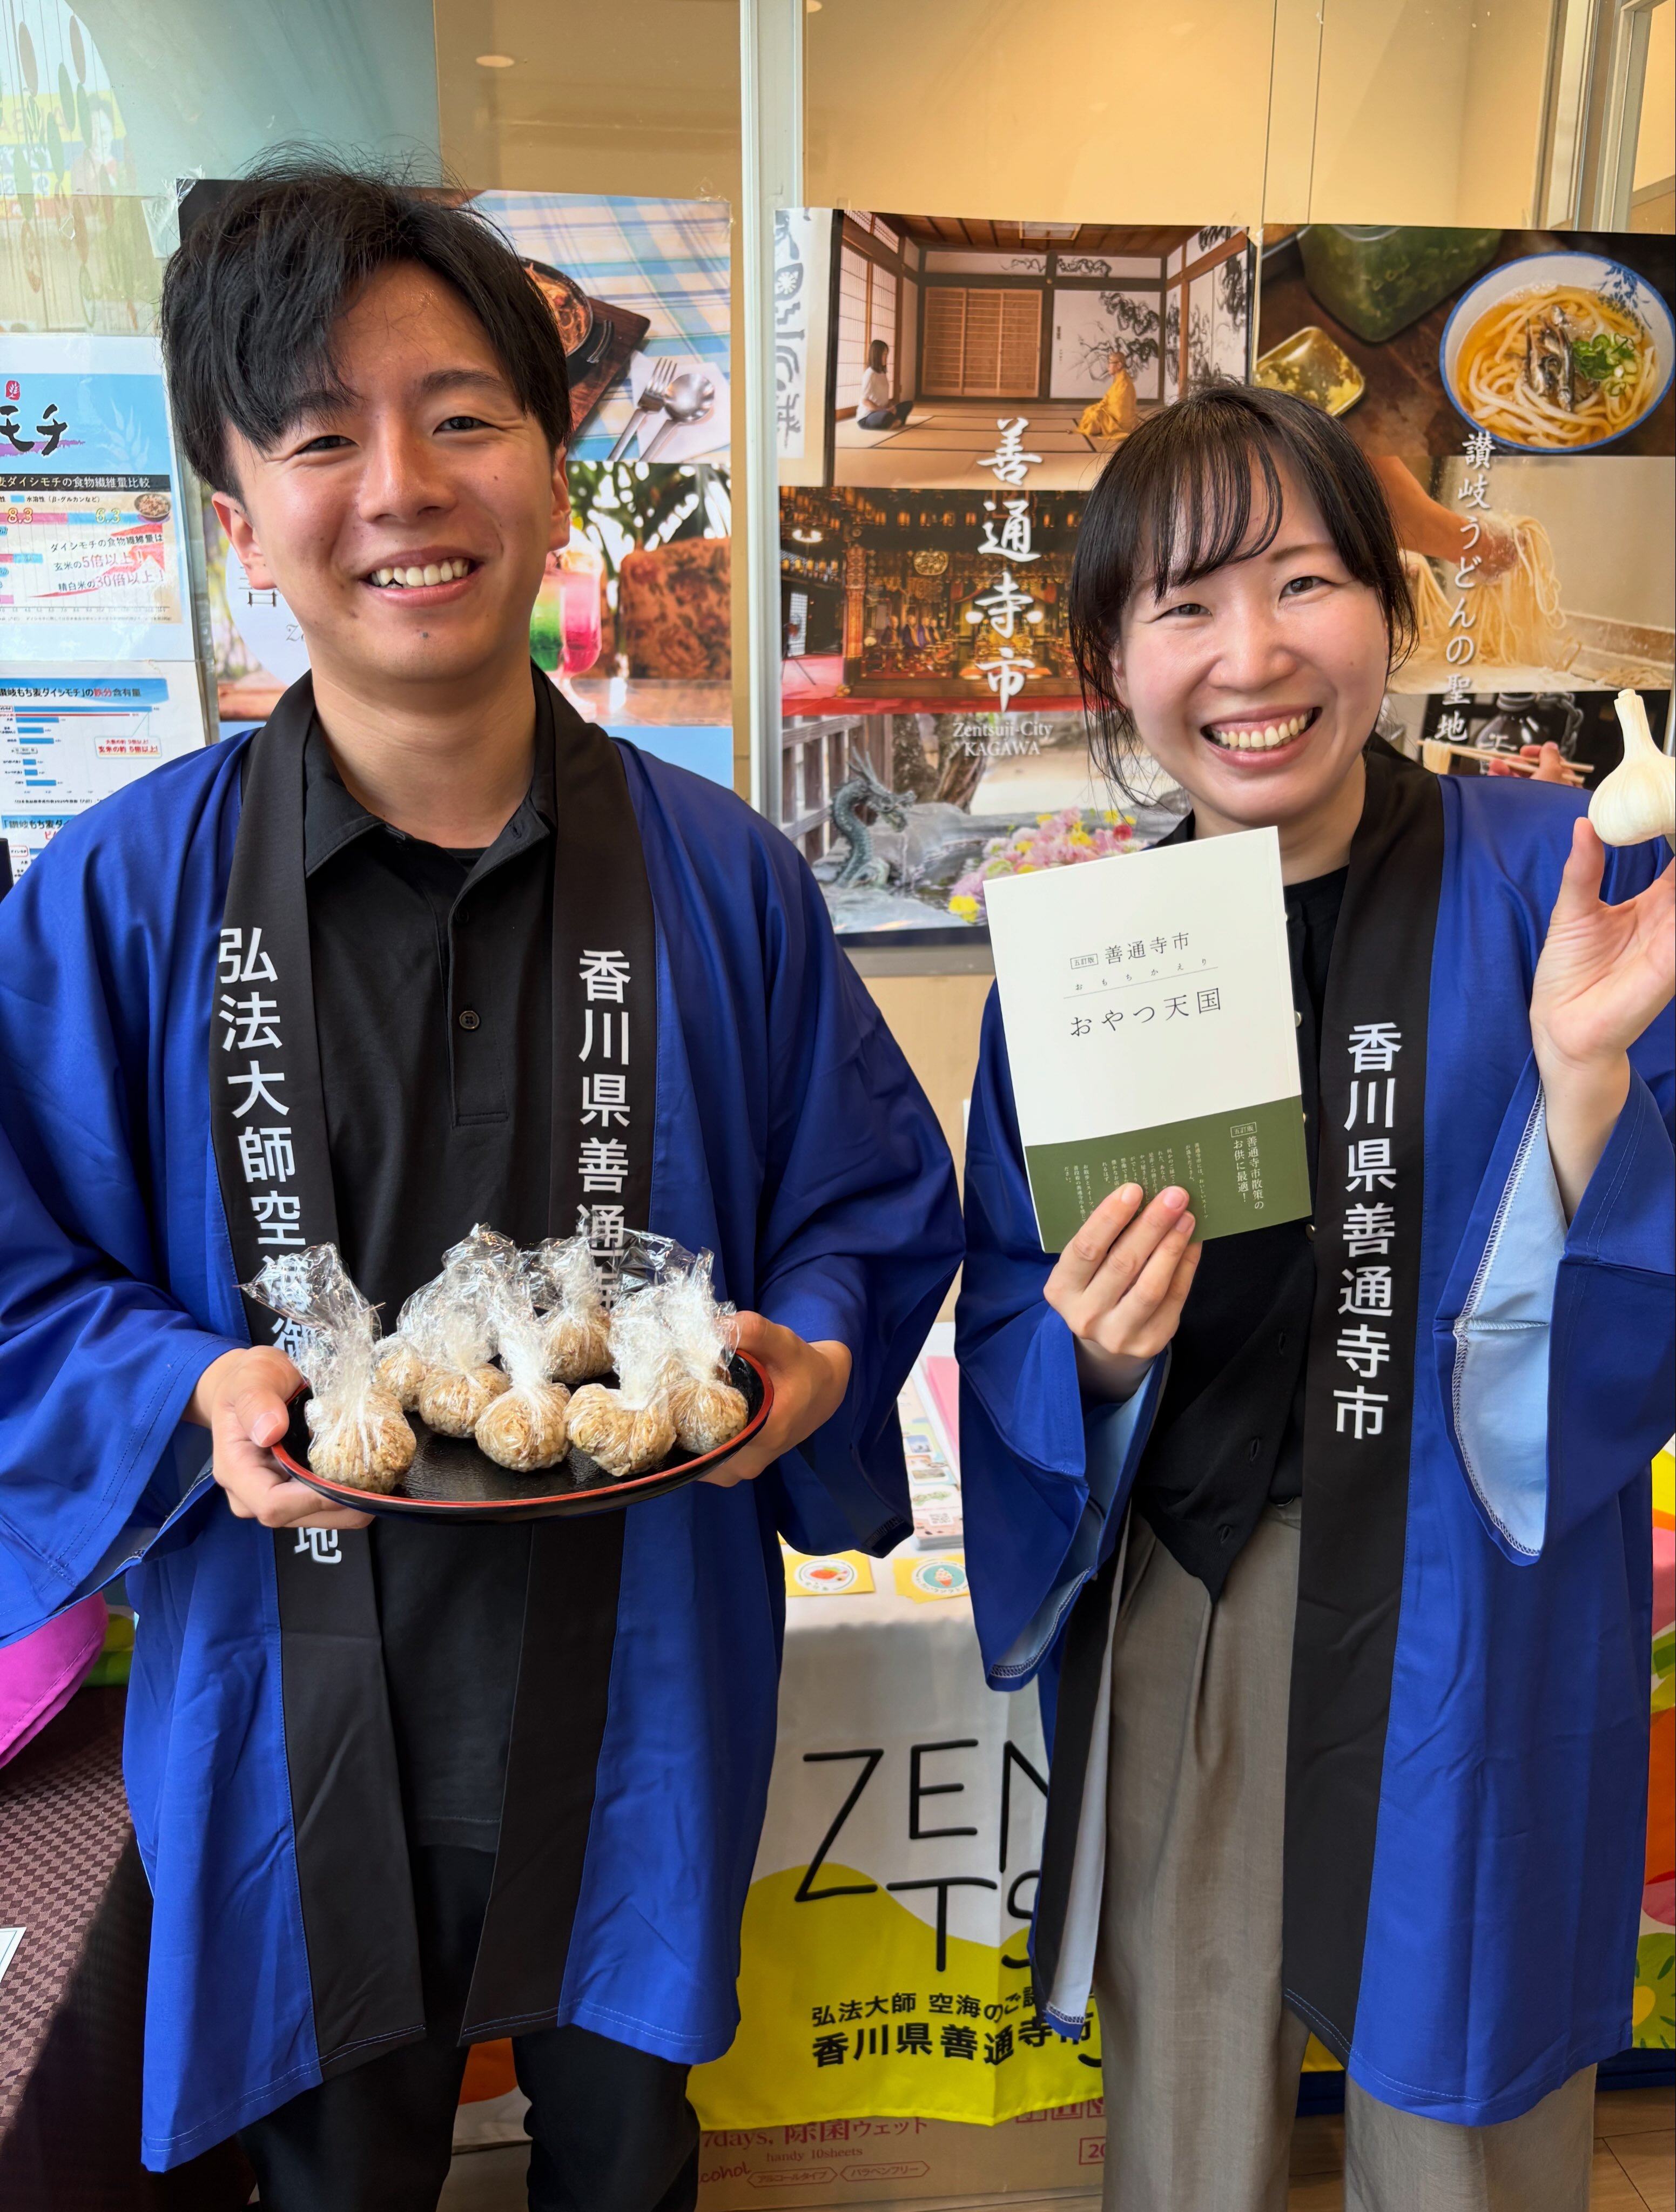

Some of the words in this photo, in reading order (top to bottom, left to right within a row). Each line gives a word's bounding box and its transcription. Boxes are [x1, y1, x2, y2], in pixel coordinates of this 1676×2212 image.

[8, 508, 33, 524] 8.3
[95, 508, 122, 524] 6.3
[975, 416, 1043, 712] 善通寺市
[1434, 430, 1496, 741] 讃岐うどんの聖地
[953, 721, 1053, 740] Zentsuji-City
[964, 740, 1041, 757] KAGAWA
[1105, 932, 1189, 965] 善通寺市
[1075, 958, 1207, 991] おもちかえり
[1070, 987, 1221, 1037] おやつ天国
[1247, 1136, 1264, 1209] 善通寺市散策の
[1333, 1022, 1403, 1440] 香川県善通寺市
[812, 1992, 917, 2027] 弘法大師
[766, 2152, 805, 2163] handy
[811, 2147, 863, 2159] 10sheets
[699, 2161, 752, 2183] cohol
